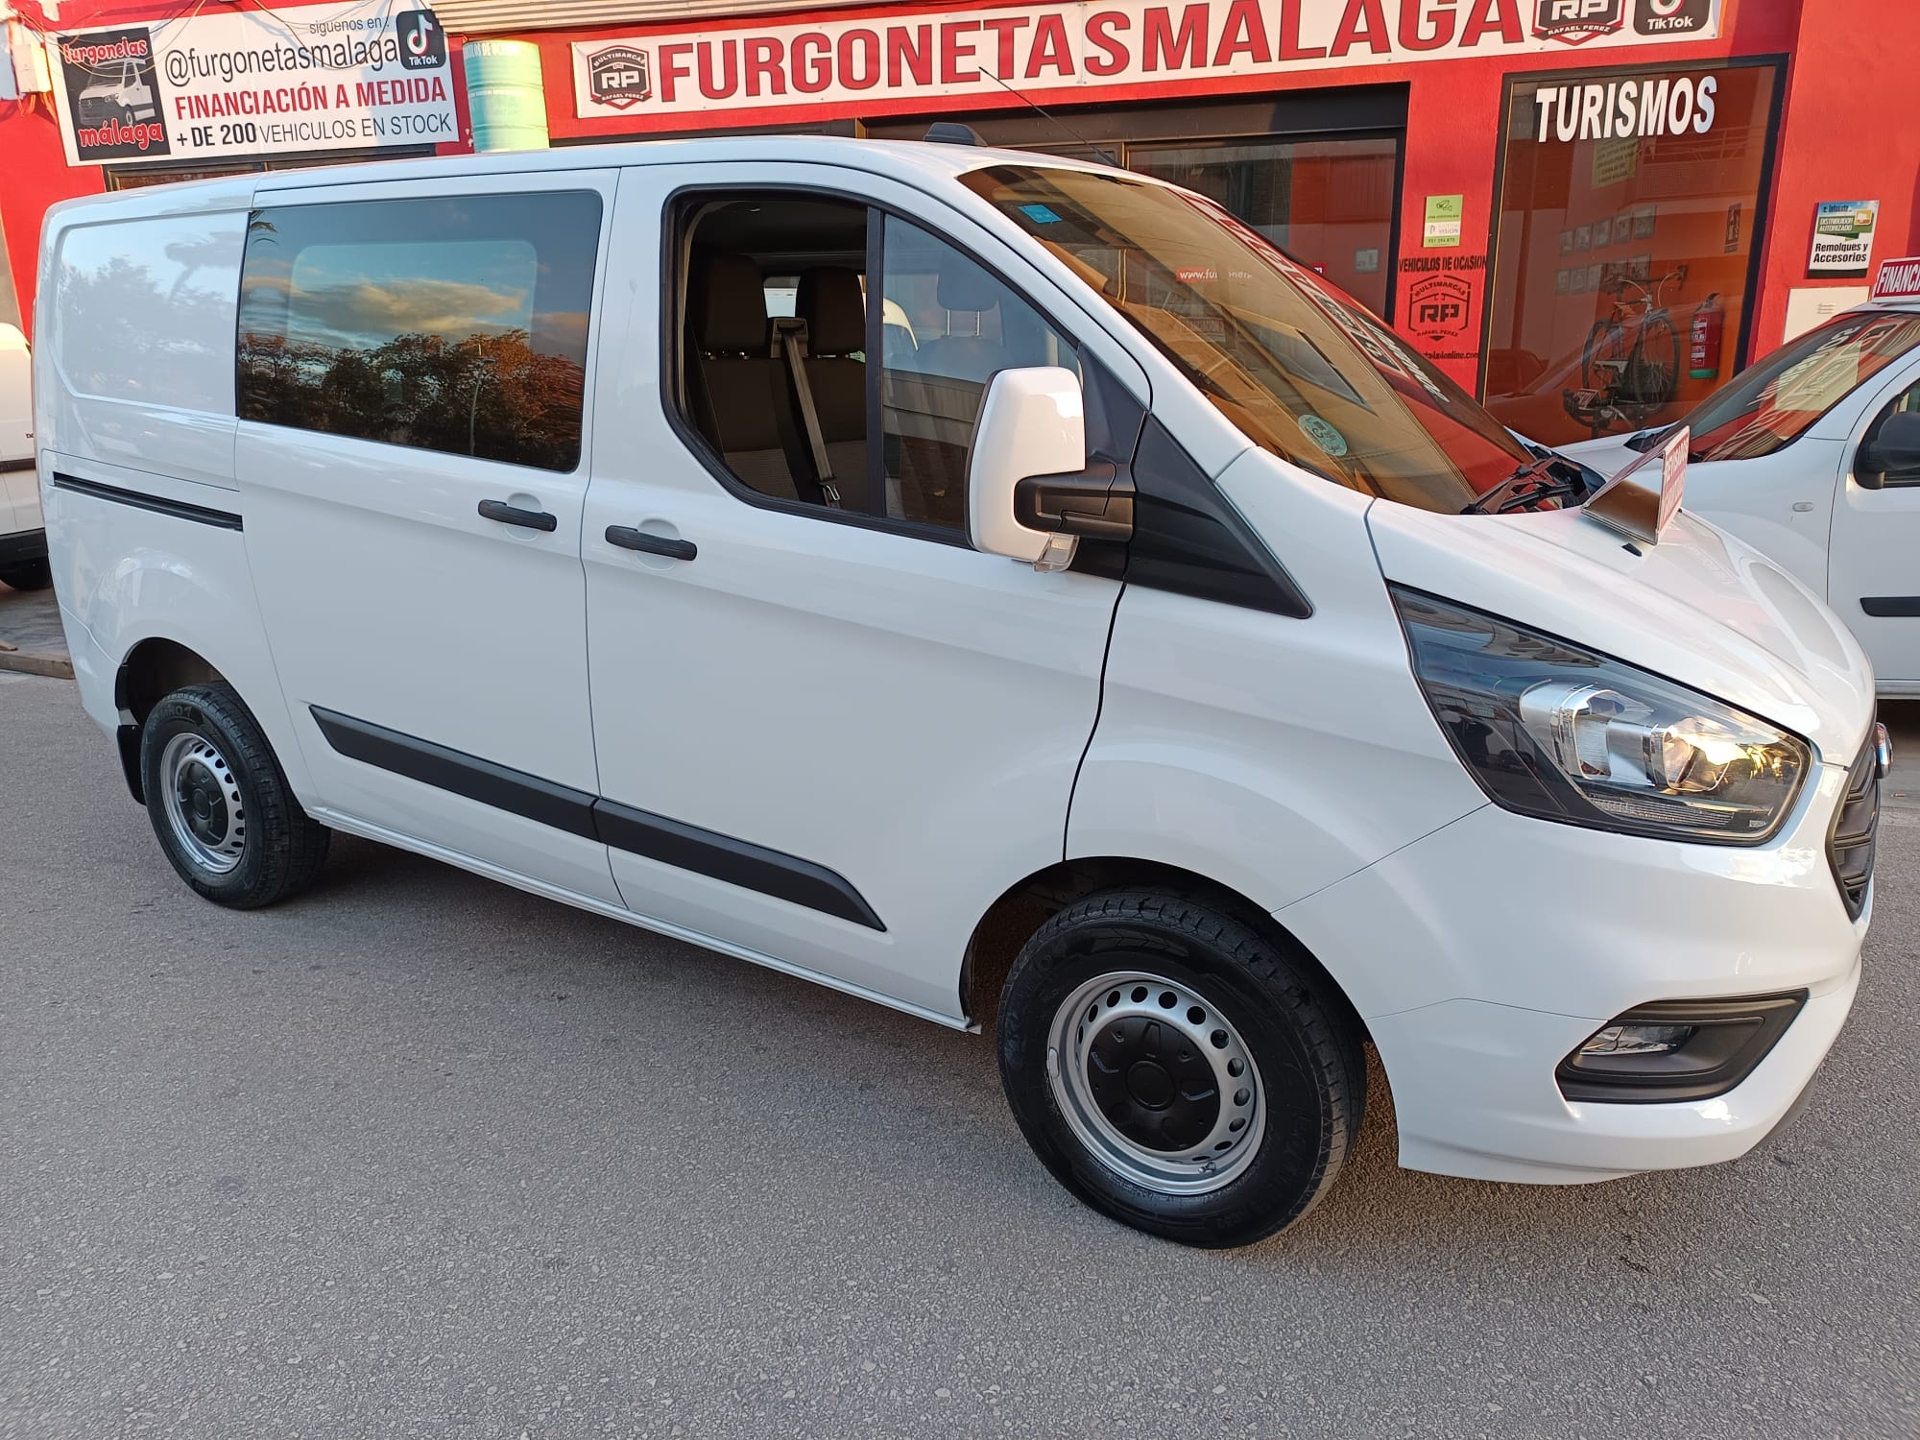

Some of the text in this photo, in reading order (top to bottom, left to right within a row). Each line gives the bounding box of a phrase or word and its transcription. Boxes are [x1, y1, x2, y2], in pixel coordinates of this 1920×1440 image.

[1551, 0, 1609, 20] RP
[309, 19, 364, 37] siguenos
[367, 17, 382, 29] en
[1548, 24, 1611, 36] RAFAEL PEREZ
[1647, 16, 1693, 31] TikTok
[62, 37, 148, 65] furgonetas
[165, 34, 399, 87] @furgonetasmalaga
[409, 55, 439, 66] TikTok
[593, 52, 646, 68] MULTIMARCAS
[601, 70, 640, 89] RP
[175, 76, 447, 120] FINANCIACIÓN A MEDIDA
[1535, 75, 1718, 143] TURISMOS
[78, 118, 164, 150] málaga
[177, 113, 453, 147] + DE 200 VEHICULOS EN STOCK
[1813, 252, 1867, 263] Accesorios
[1815, 243, 1869, 253] Remolques y
[1399, 256, 1441, 273] VEHICULOS
[1442, 257, 1453, 271] DE
[1876, 263, 1920, 294] FINANCI
[1414, 281, 1466, 297] MULTIMARCAS
[1419, 304, 1460, 323] RP
